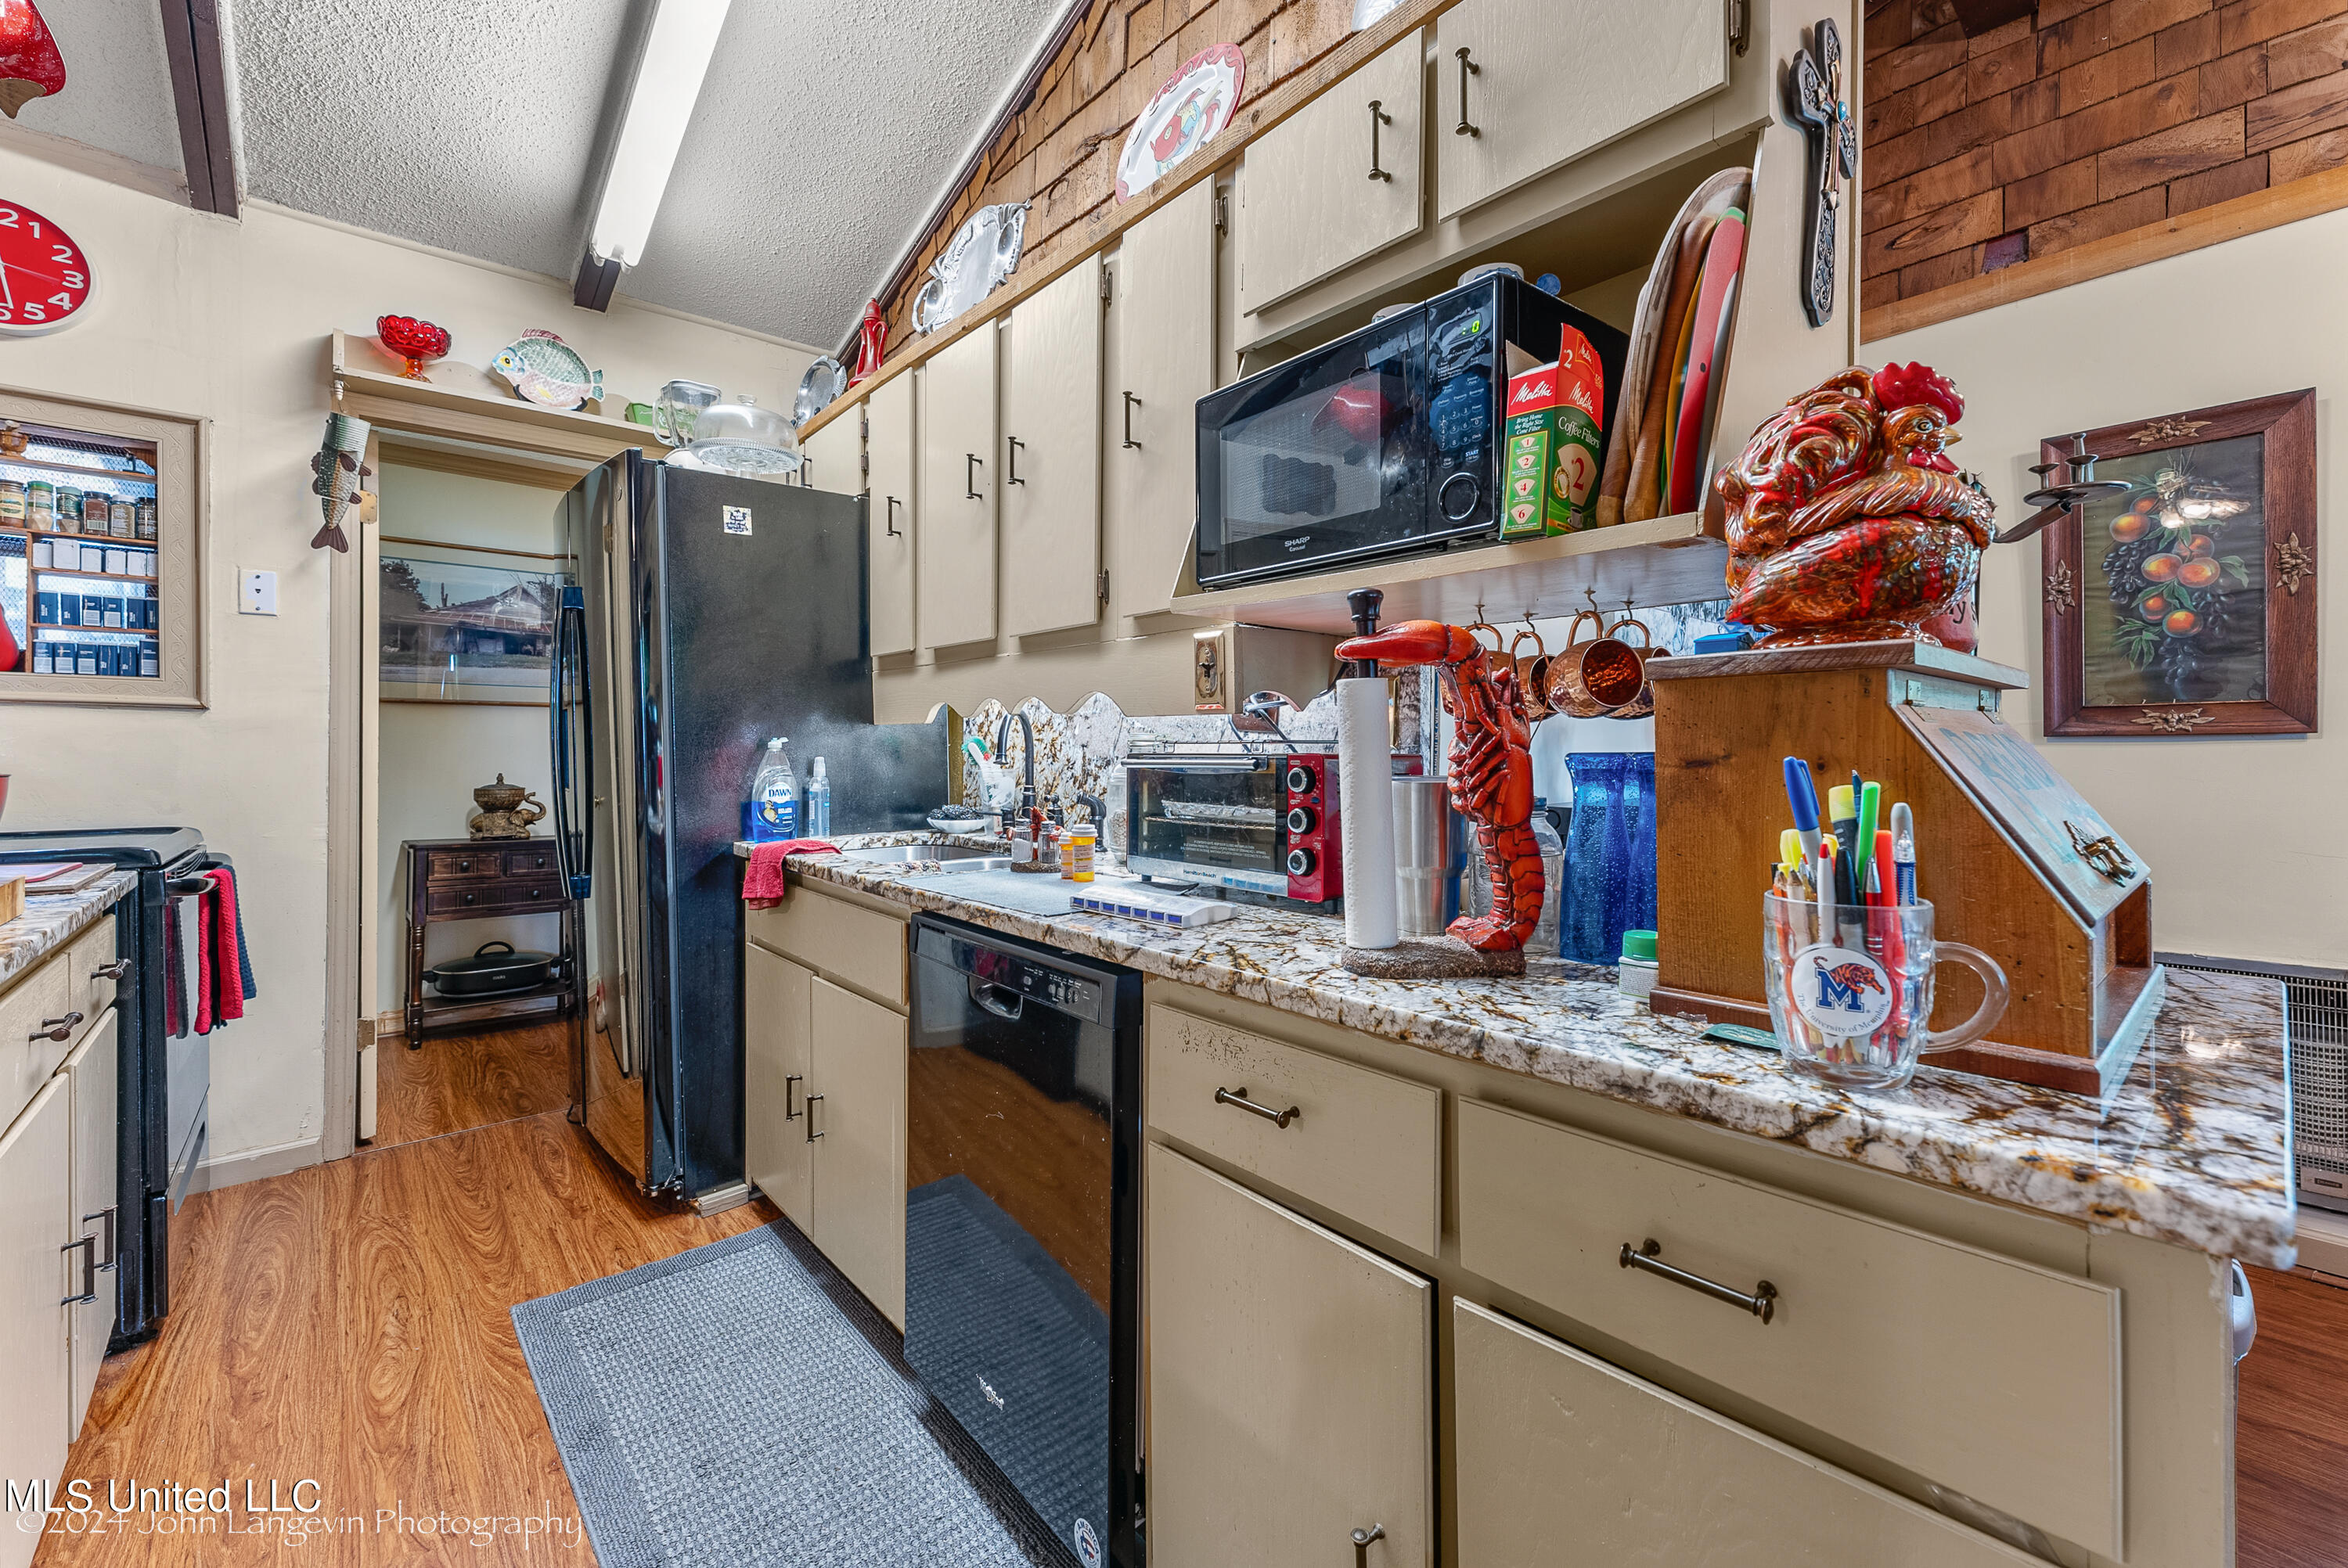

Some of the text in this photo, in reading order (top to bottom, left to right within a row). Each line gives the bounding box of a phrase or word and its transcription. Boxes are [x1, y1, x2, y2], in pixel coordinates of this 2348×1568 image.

[0, 208, 19, 228] 2
[28, 221, 40, 239] 1
[51, 245, 73, 264] 2
[62, 270, 85, 290] 3
[23, 302, 46, 321] 5
[47, 292, 73, 311] 4
[1511, 380, 1554, 405] Melitta
[1568, 381, 1594, 414] Melitta
[1558, 416, 1581, 437] Coffee
[1581, 427, 1600, 448] Filters
[1284, 536, 1310, 547] SHARP
[769, 788, 792, 797] DAWN
[1806, 1009, 1848, 1034] University
[1858, 1002, 1887, 1030] Memphis
[1076, 1520, 1100, 1555] AMERICA
